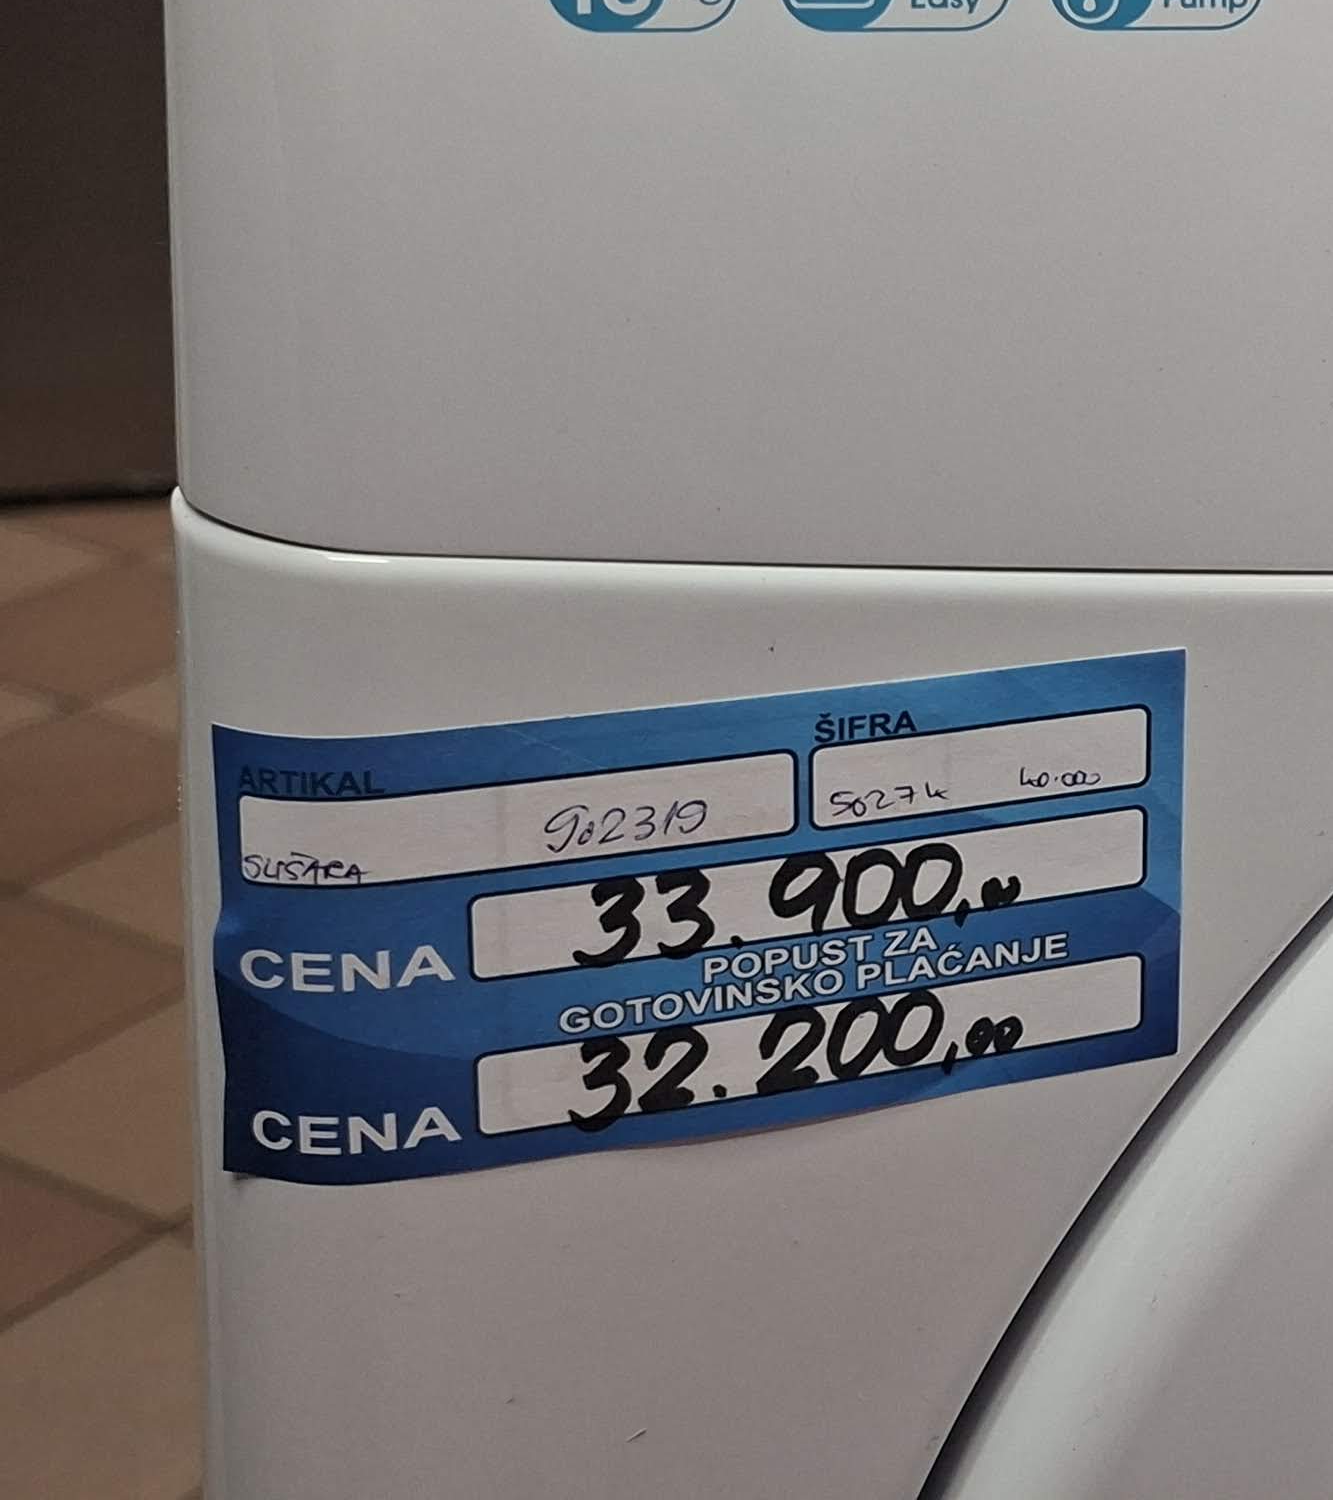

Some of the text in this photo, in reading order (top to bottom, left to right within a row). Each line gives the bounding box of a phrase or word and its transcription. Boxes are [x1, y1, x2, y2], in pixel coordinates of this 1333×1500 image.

[814, 711, 918, 743] ŠIFRA
[239, 766, 385, 796] ARTIKAL
[239, 946, 454, 994] CENA
[704, 927, 939, 984] POPUST ZA
[558, 931, 1070, 1036] GOTOVINSKO PLAĆANJE
[251, 1106, 462, 1158] CENA
